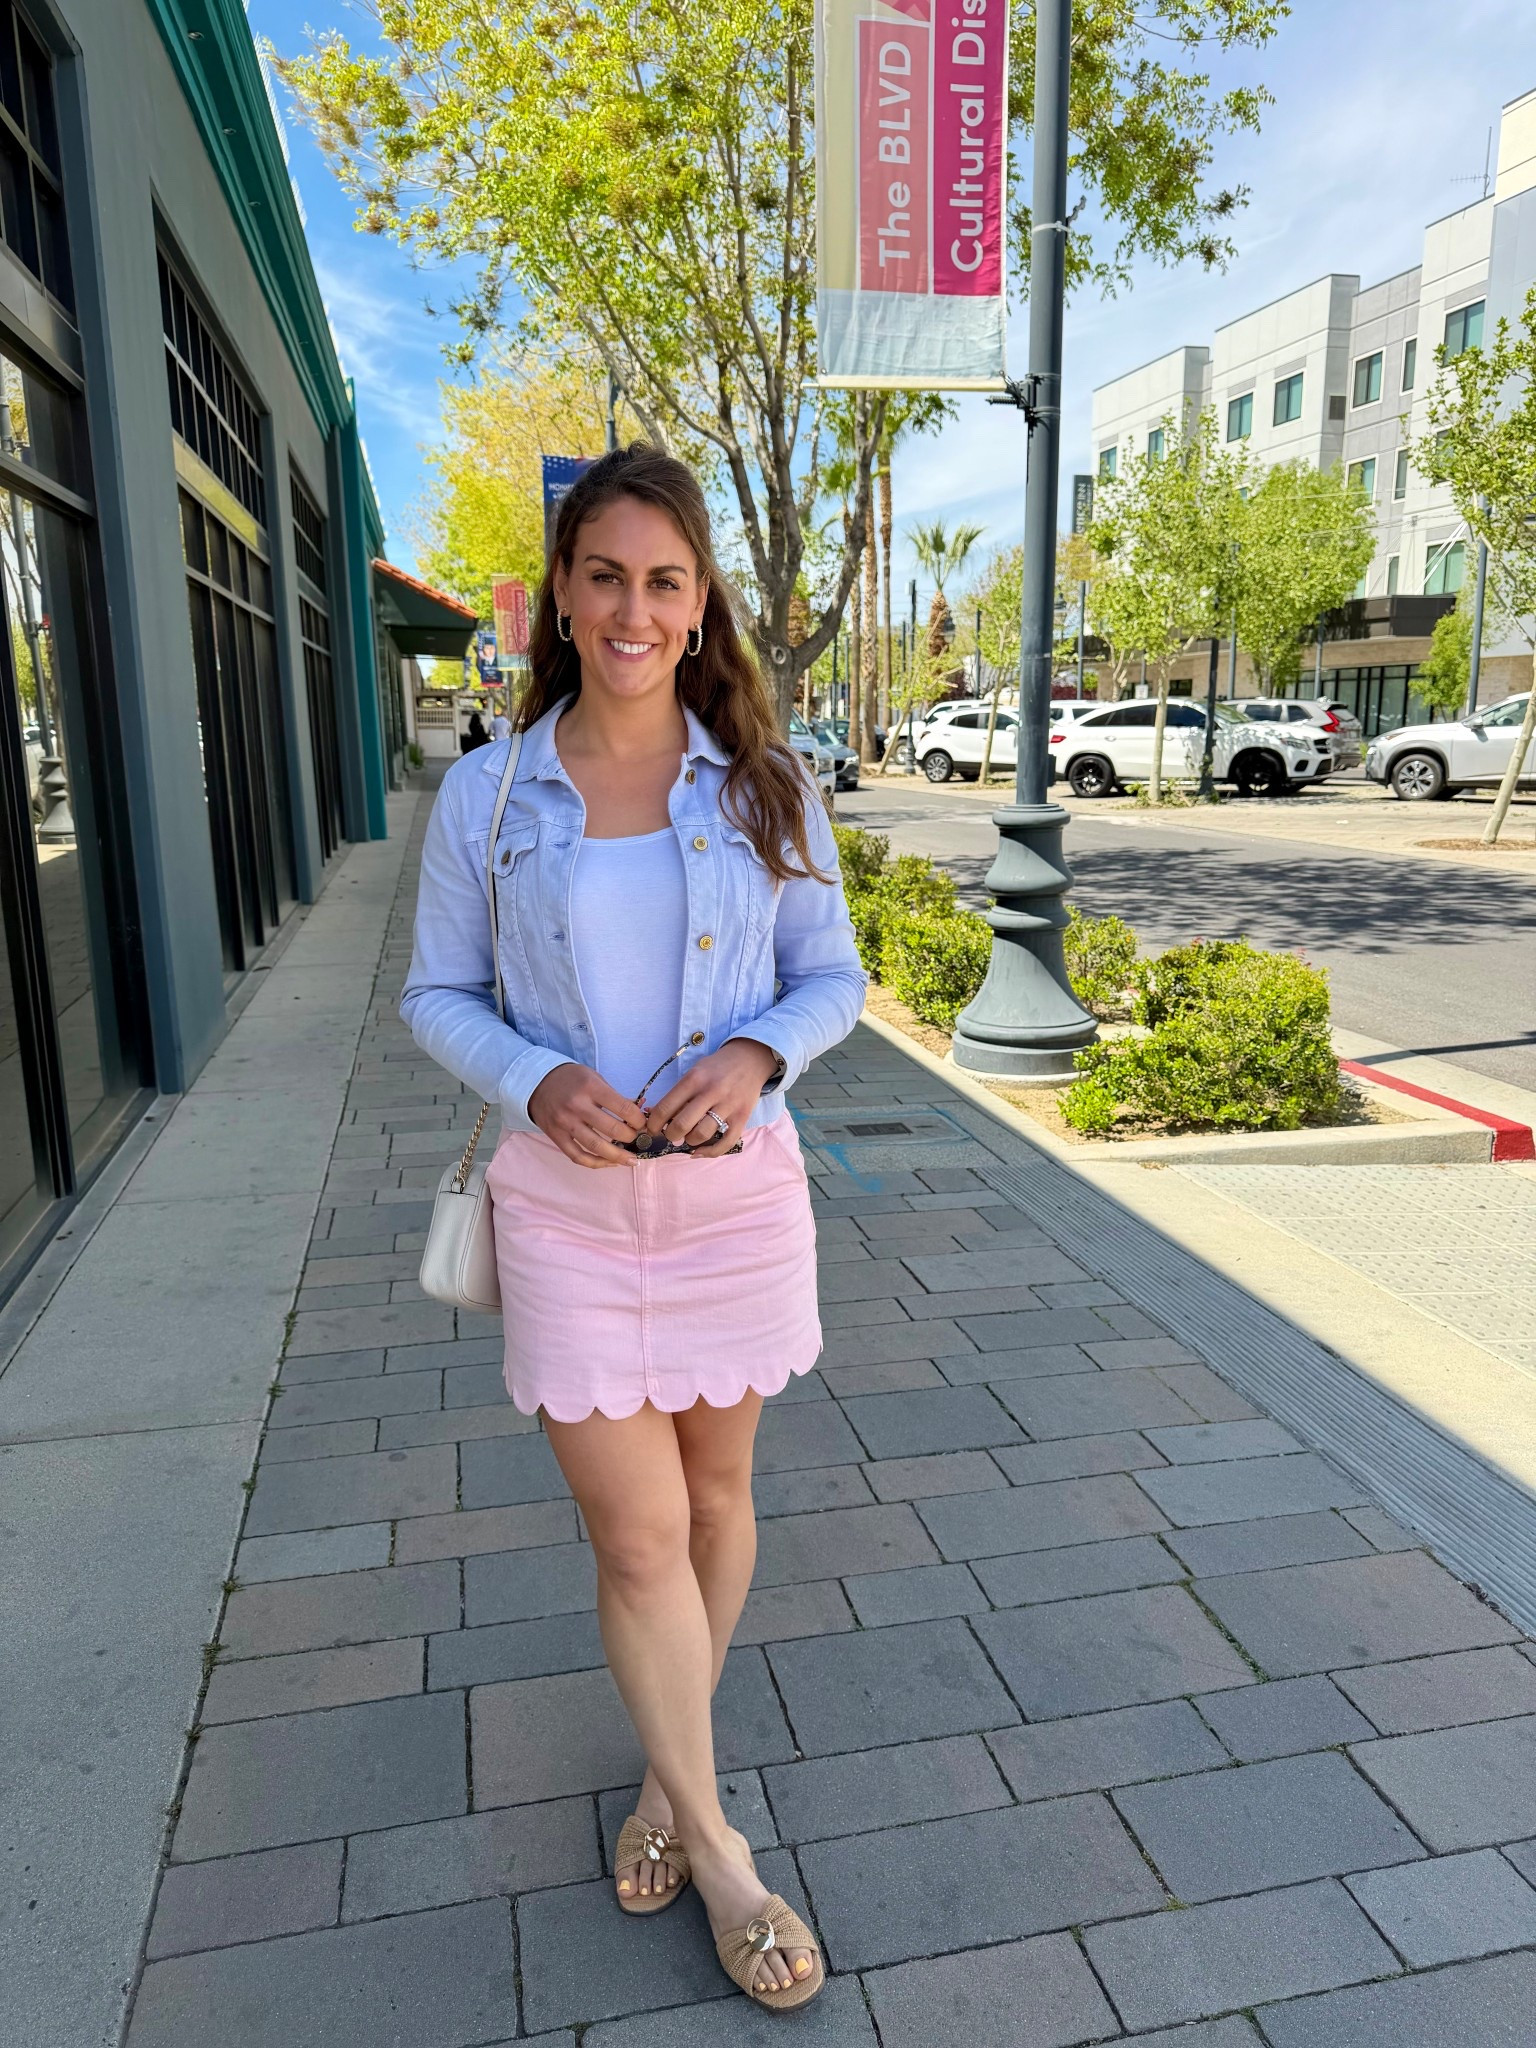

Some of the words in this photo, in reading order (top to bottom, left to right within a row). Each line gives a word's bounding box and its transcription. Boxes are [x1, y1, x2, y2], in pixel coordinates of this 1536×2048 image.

[878, 41, 912, 165] BLVD
[878, 181, 911, 268] The
[950, 83, 985, 273] Cultural
[1077, 483, 1086, 500] INN
